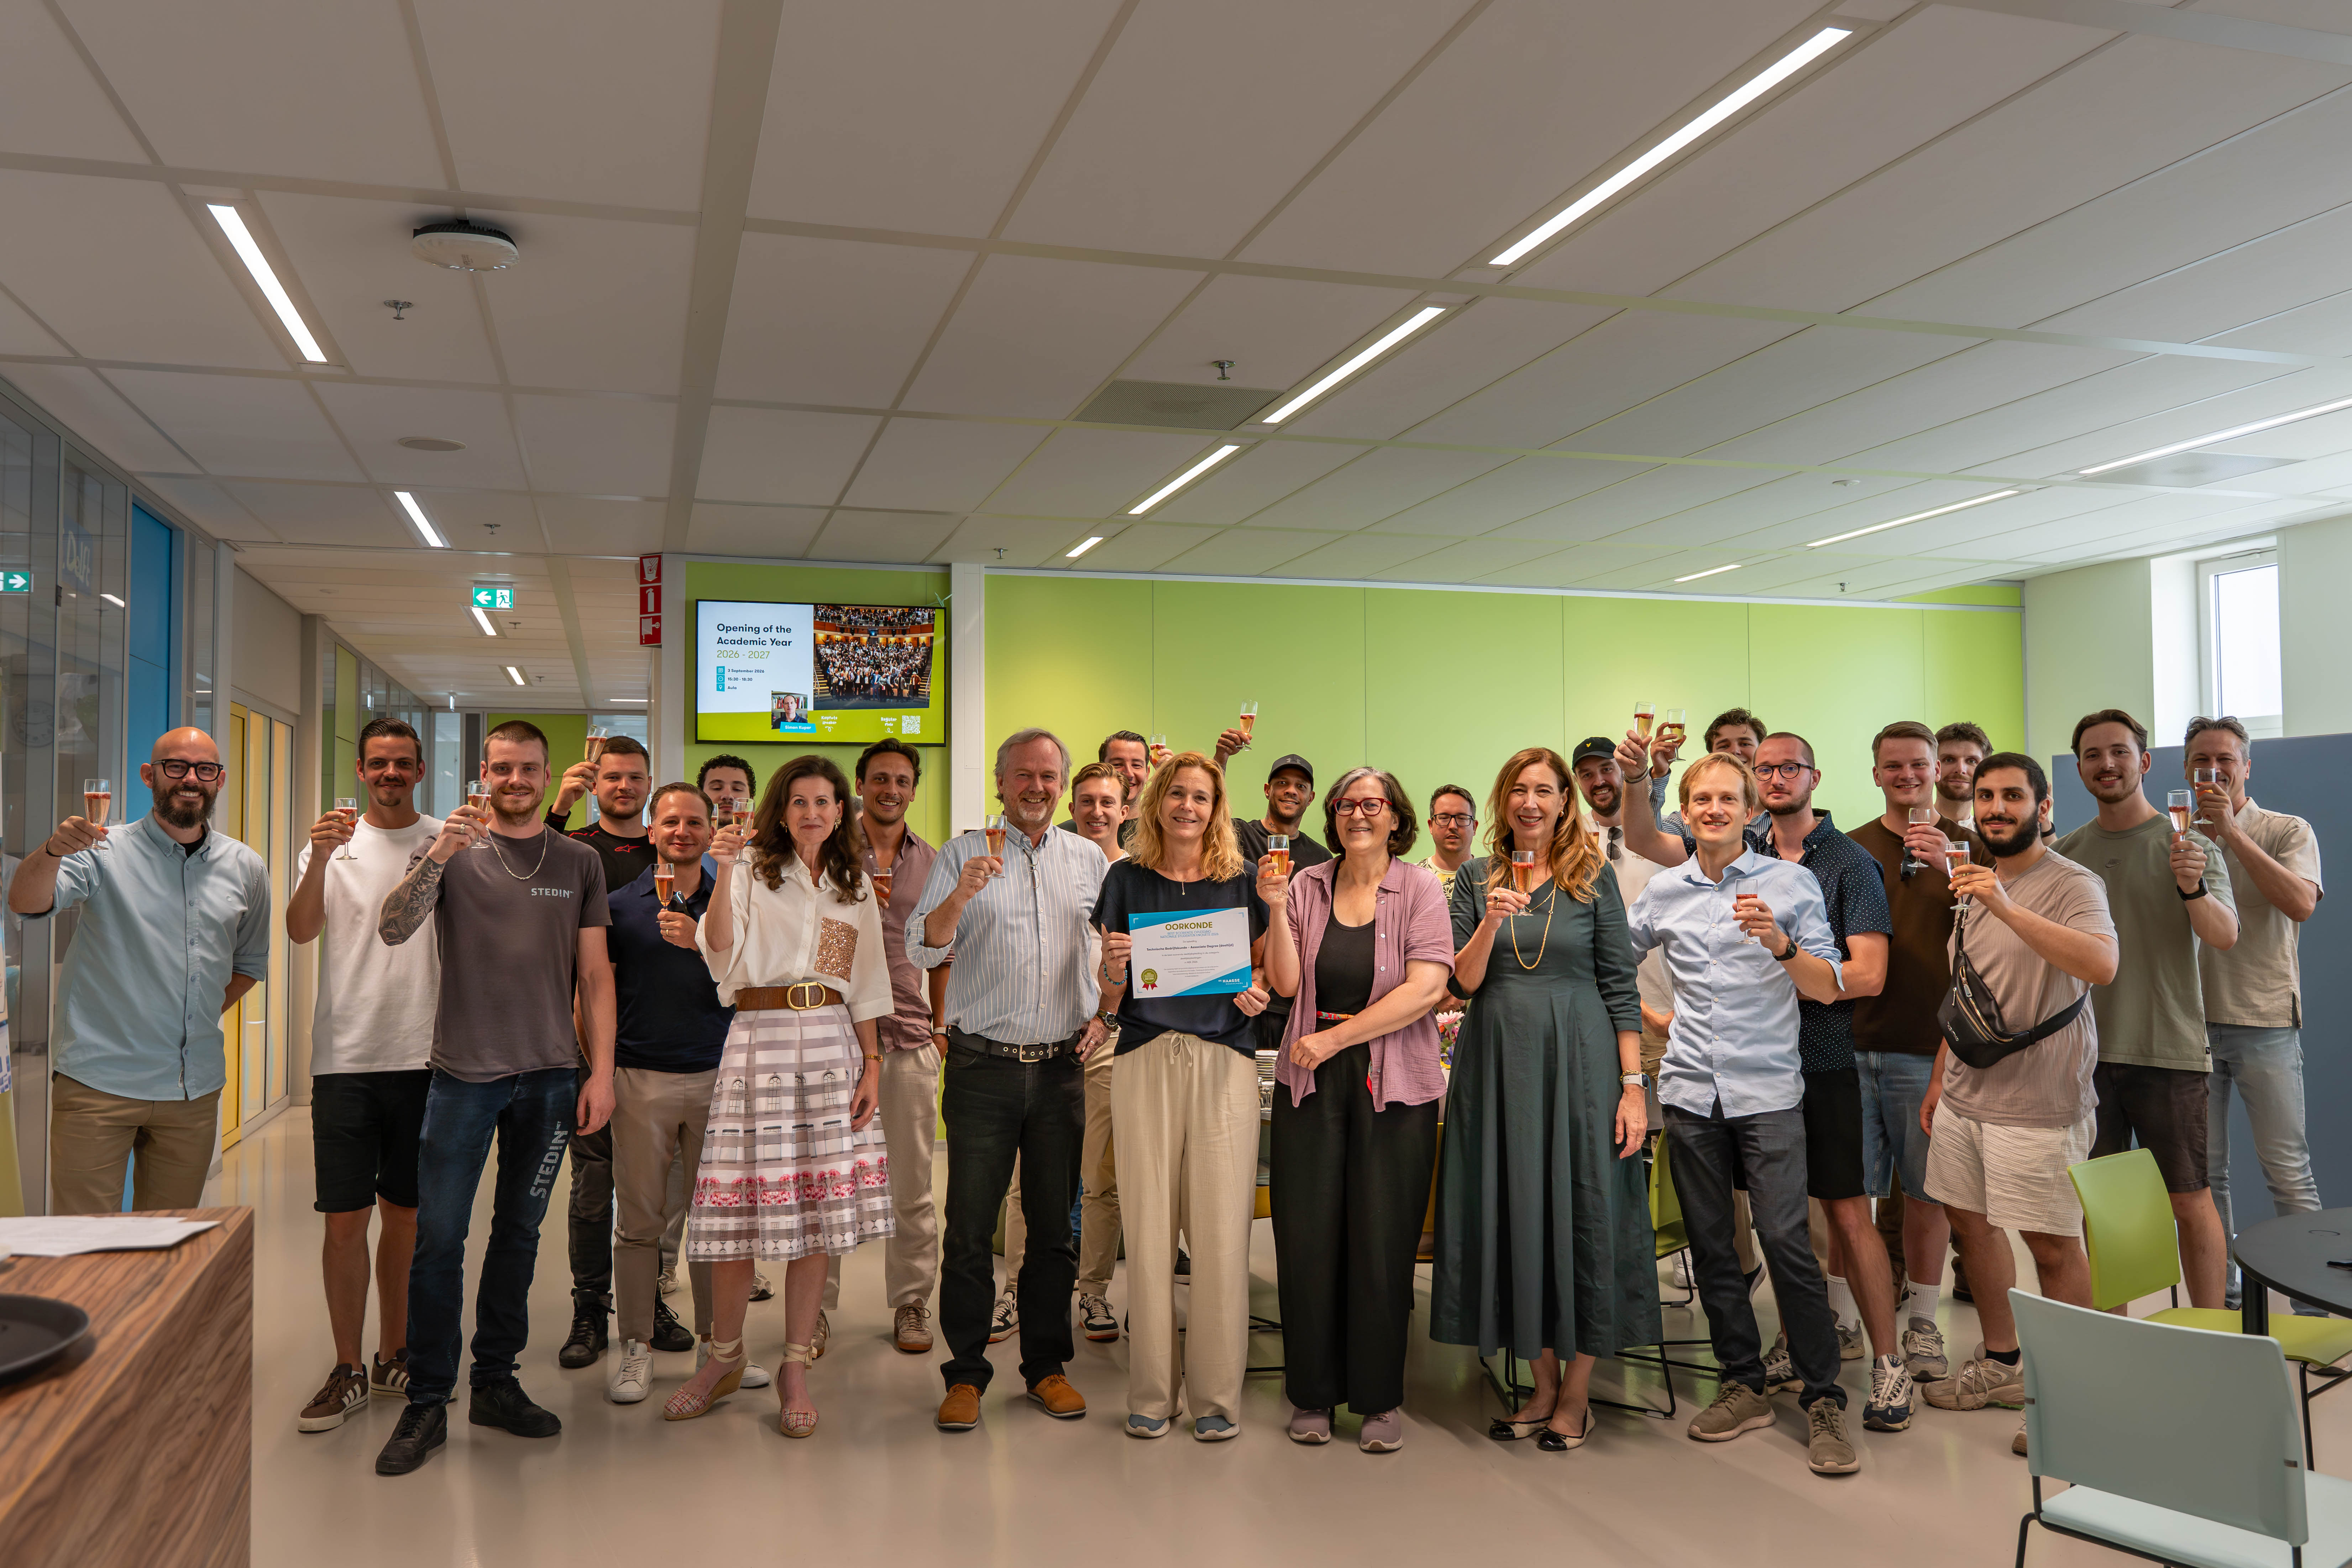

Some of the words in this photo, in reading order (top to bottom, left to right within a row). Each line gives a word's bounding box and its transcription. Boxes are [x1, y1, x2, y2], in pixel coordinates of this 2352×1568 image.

[717, 624, 760, 634] Opening
[717, 637, 767, 646] Academic
[717, 650, 739, 658] 2026
[531, 888, 570, 898] STEDIN
[1165, 922, 1212, 930] OORKONDE
[530, 1131, 568, 1199] STEDIN
